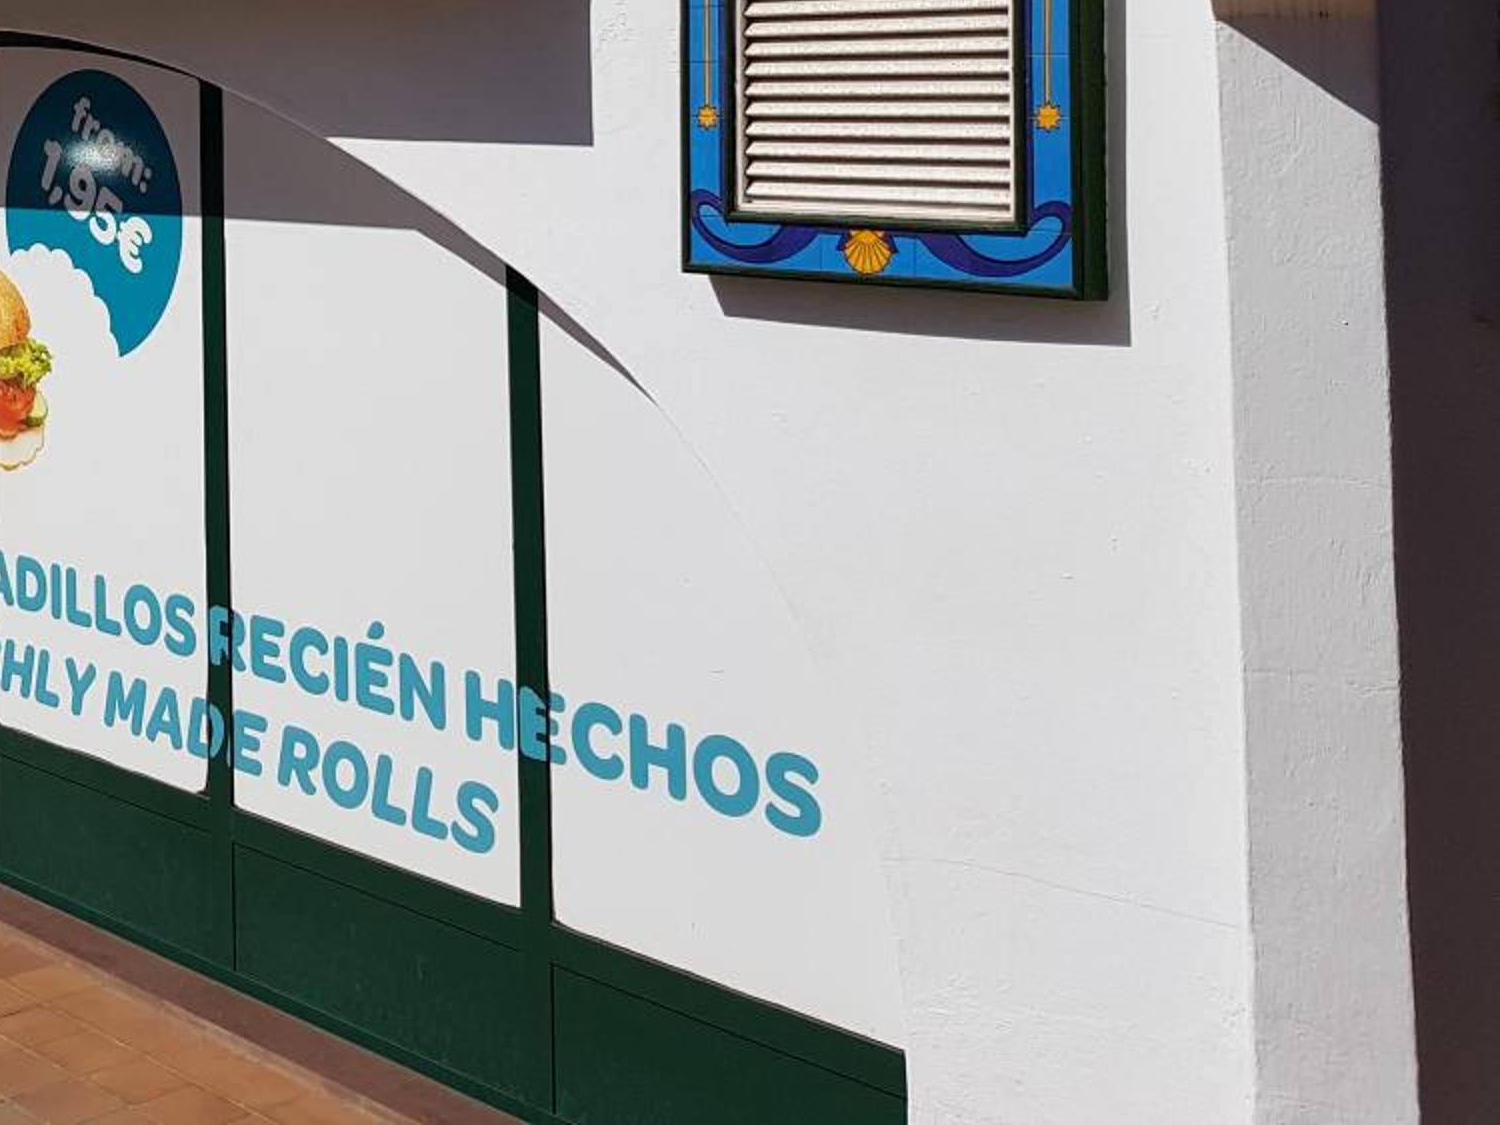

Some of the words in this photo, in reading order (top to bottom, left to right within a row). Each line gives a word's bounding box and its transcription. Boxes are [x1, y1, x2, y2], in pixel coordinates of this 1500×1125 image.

[103, 671, 268, 777] MADE
[278, 725, 499, 853] ROLLS
[209, 604, 446, 730] RECIÉN
[465, 670, 822, 837] HECHOS
